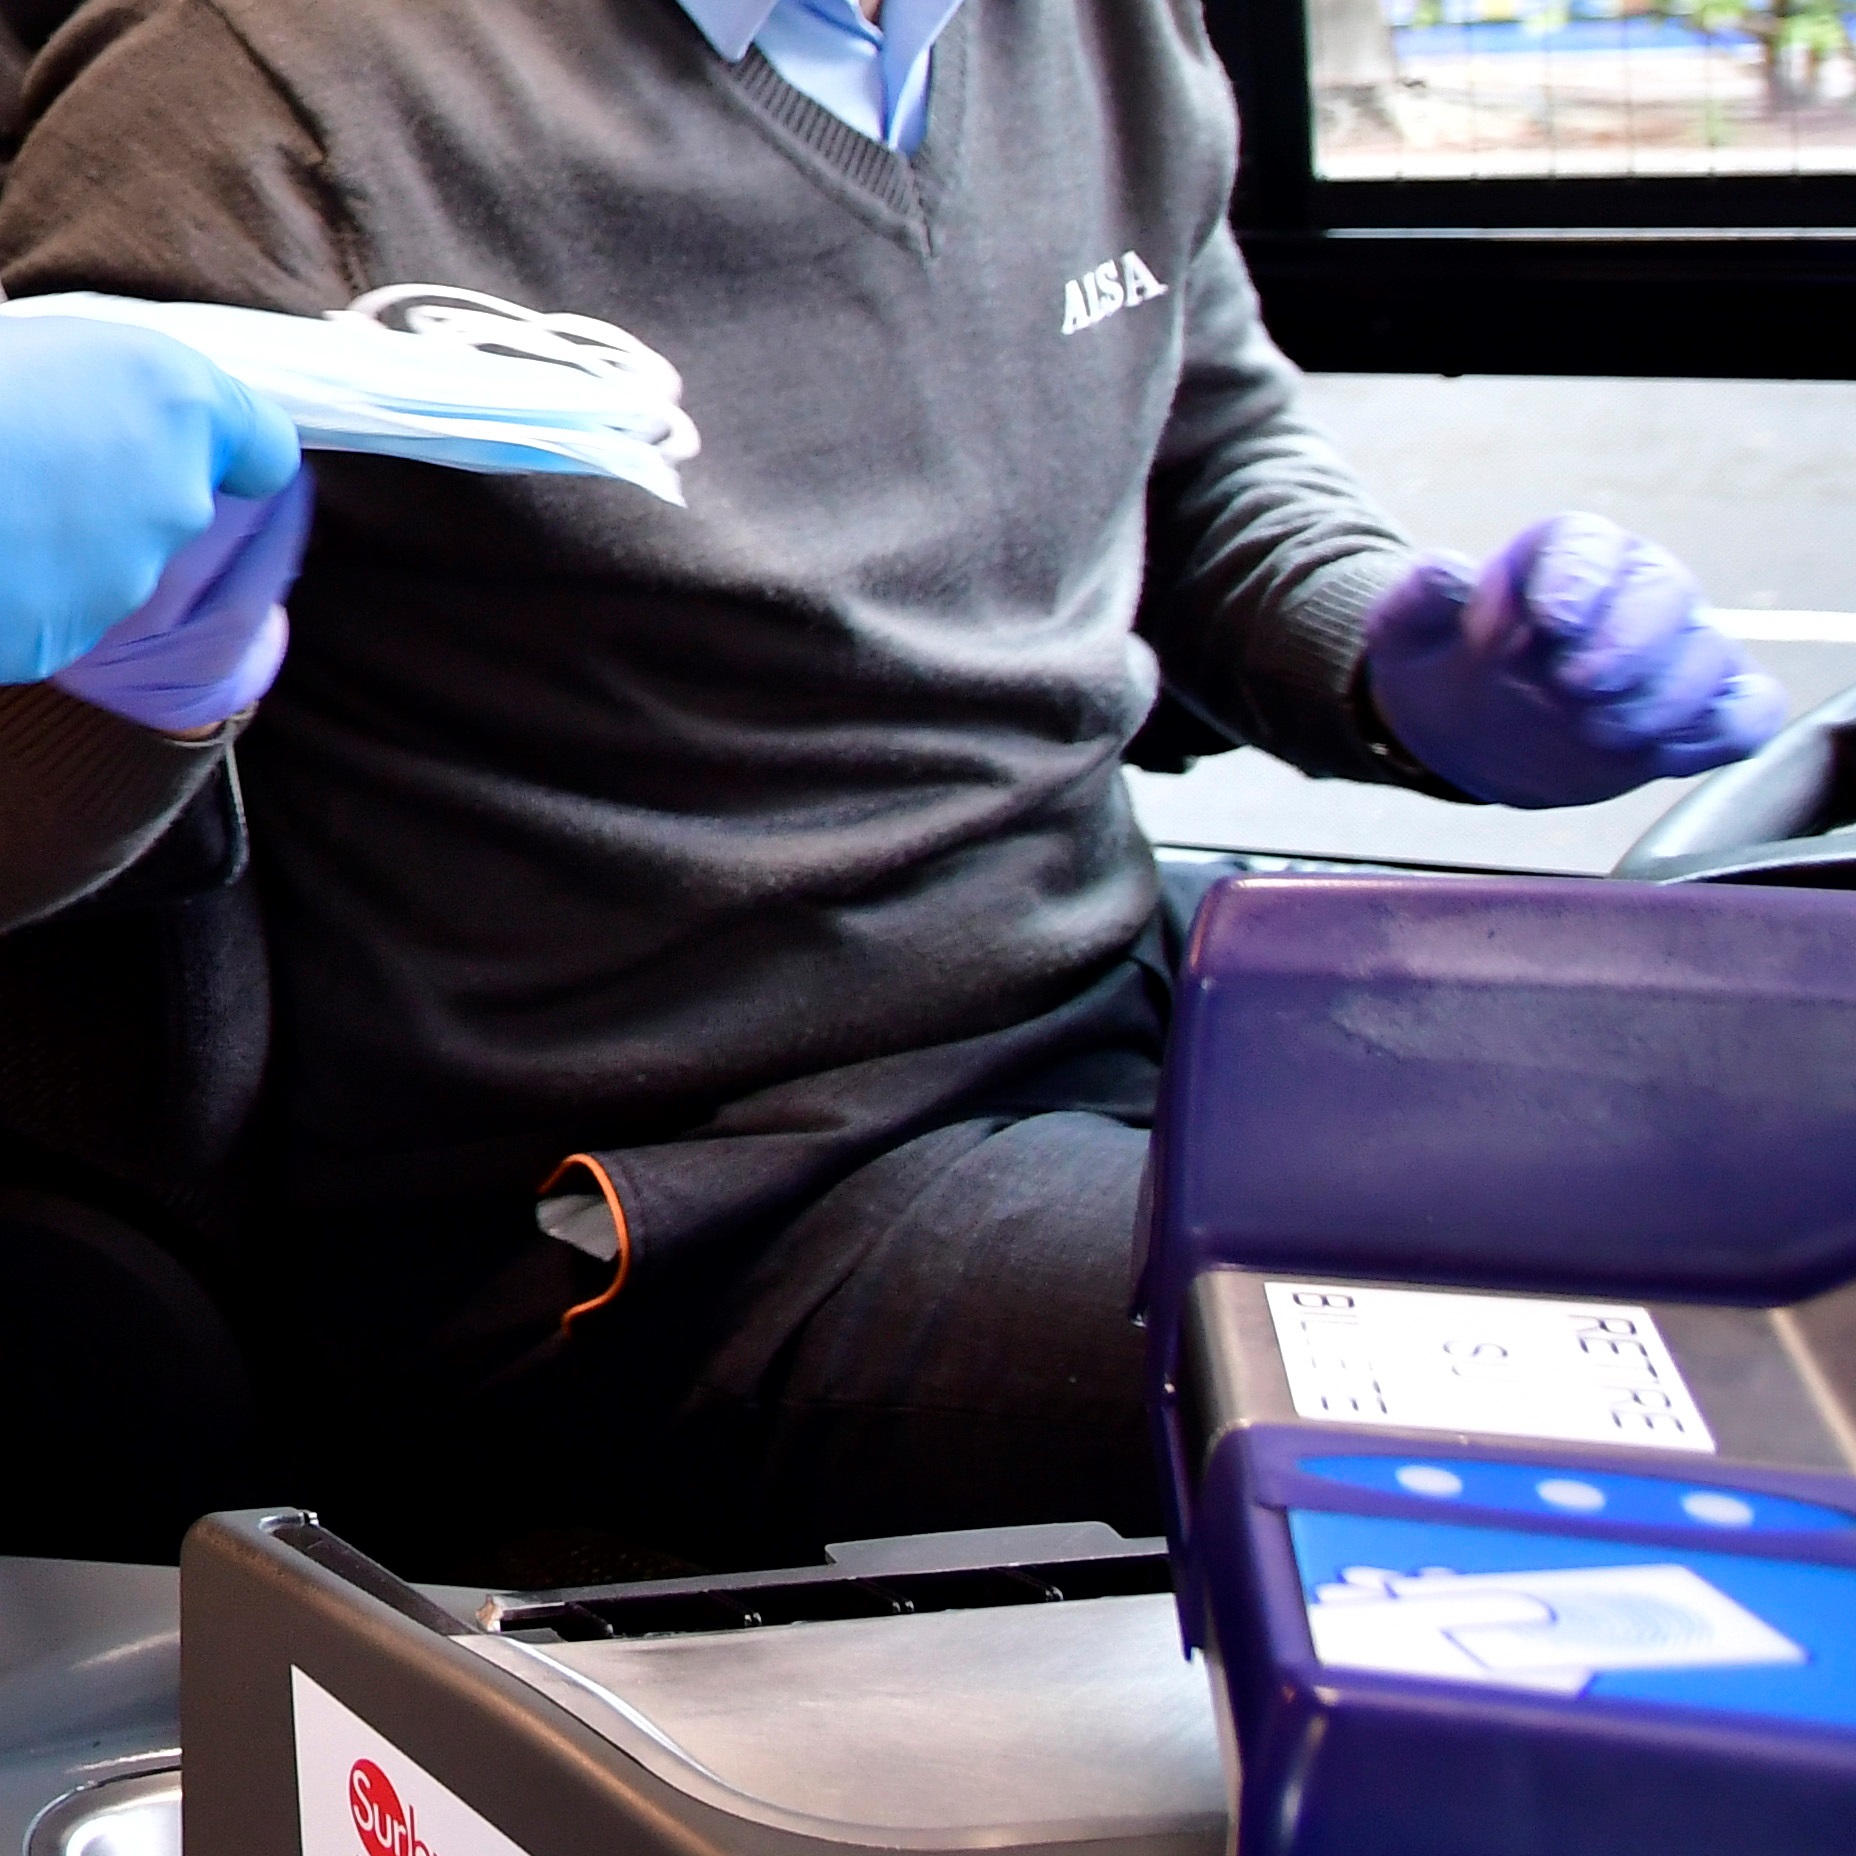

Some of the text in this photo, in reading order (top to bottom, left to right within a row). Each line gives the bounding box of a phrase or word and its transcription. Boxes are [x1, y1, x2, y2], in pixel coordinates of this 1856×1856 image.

[1061, 250, 1169, 335] ALSA
[1567, 1313, 1685, 1434] RETIRE
[353, 1770, 438, 1856] Surb
